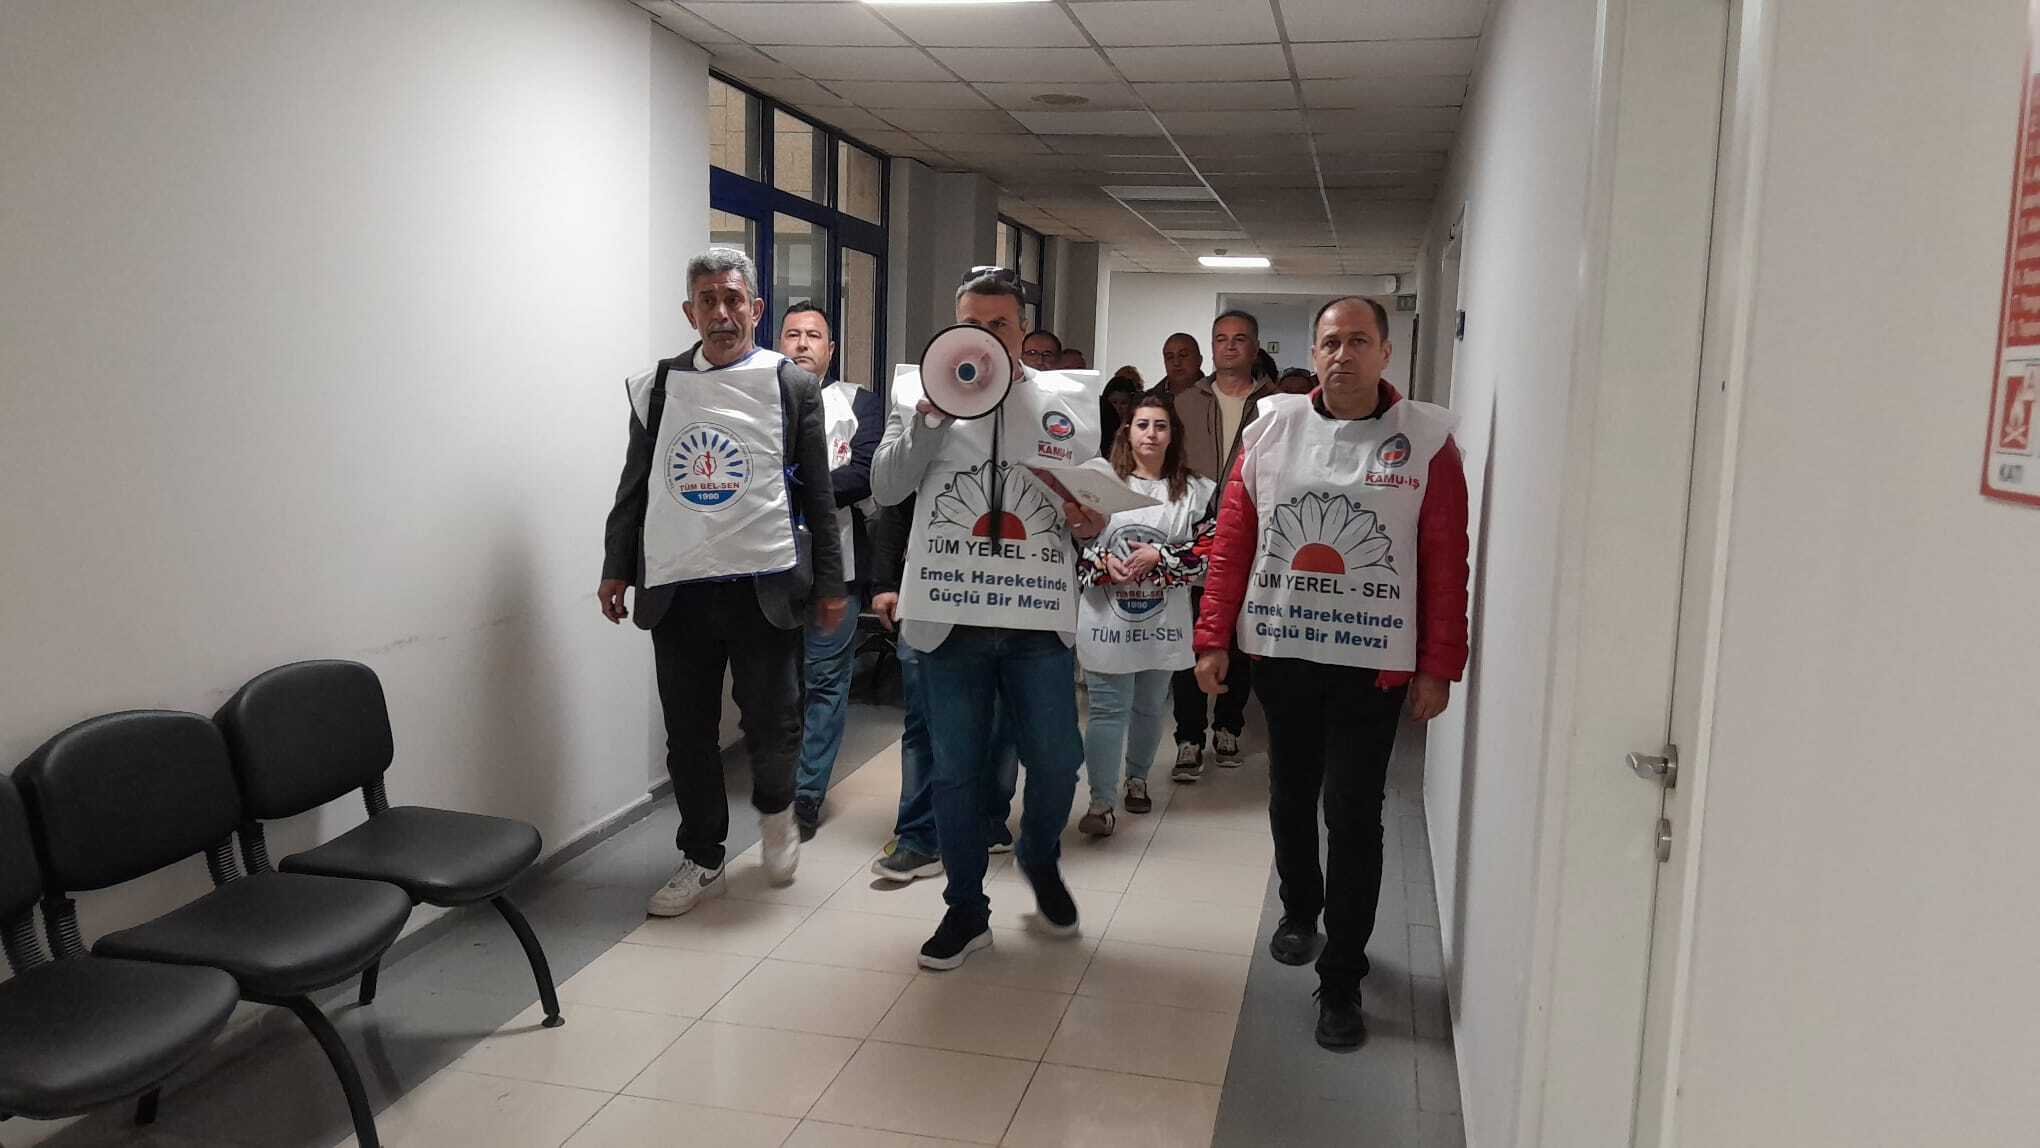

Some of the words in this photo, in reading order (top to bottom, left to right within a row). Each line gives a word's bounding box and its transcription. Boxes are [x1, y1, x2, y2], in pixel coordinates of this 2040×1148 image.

[680, 483, 697, 491] TÜM
[928, 536, 959, 554] TÜM
[1041, 547, 1065, 565] SEN
[920, 567, 965, 583] Emek
[971, 571, 1067, 592] Hareketinde
[1253, 570, 1281, 589] TÜM
[1287, 576, 1344, 595] YEREL
[1362, 582, 1400, 600] SEN
[929, 588, 980, 606] Güçlü
[987, 592, 1012, 606] Bir
[1018, 594, 1060, 611] Mevzi
[1247, 600, 1282, 617] Emek
[1289, 604, 1404, 629] Hareketinde
[1092, 627, 1121, 643] TÜM
[1125, 628, 1184, 642] BEL-SEN
[1255, 622, 1299, 642] Güçlü
[1305, 627, 1329, 643] Bir
[1335, 631, 1388, 649] Mevzi
